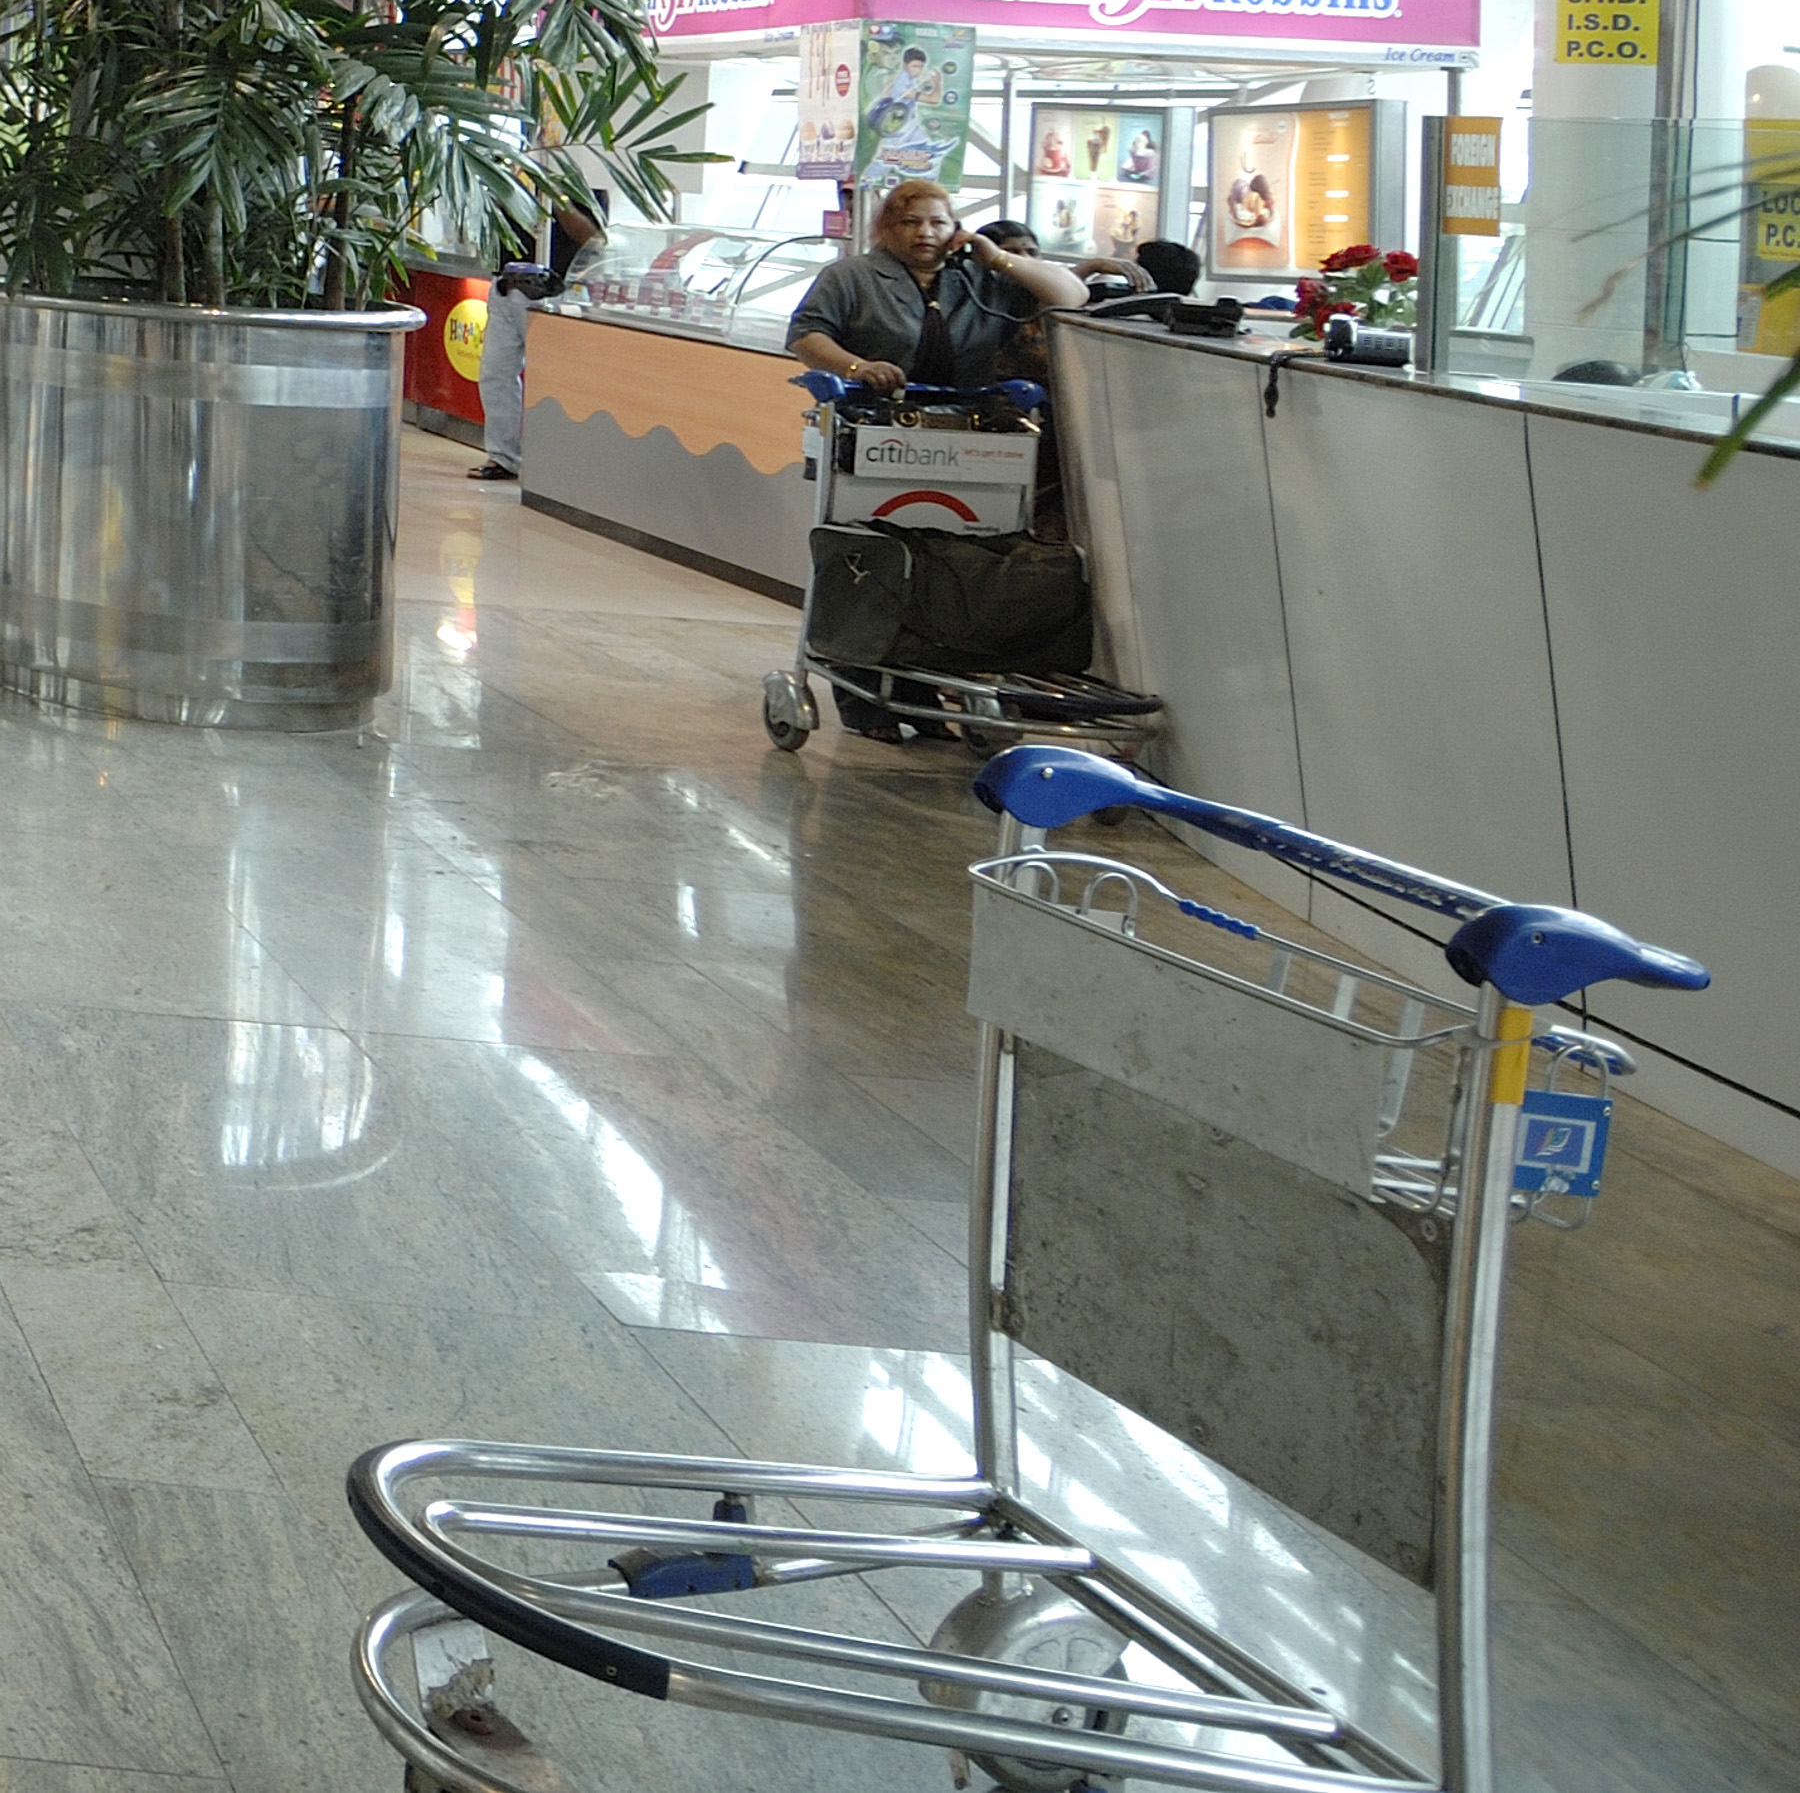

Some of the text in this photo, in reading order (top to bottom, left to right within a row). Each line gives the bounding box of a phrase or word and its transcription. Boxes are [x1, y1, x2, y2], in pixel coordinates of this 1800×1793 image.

[1567, 13, 1641, 31] I.S.D.
[1384, 47, 1456, 63] Ice Cream
[1566, 40, 1647, 59] P.C.O.
[1762, 191, 1800, 215] LOC
[1765, 223, 1800, 248] P.C.
[865, 440, 960, 467] citibank
